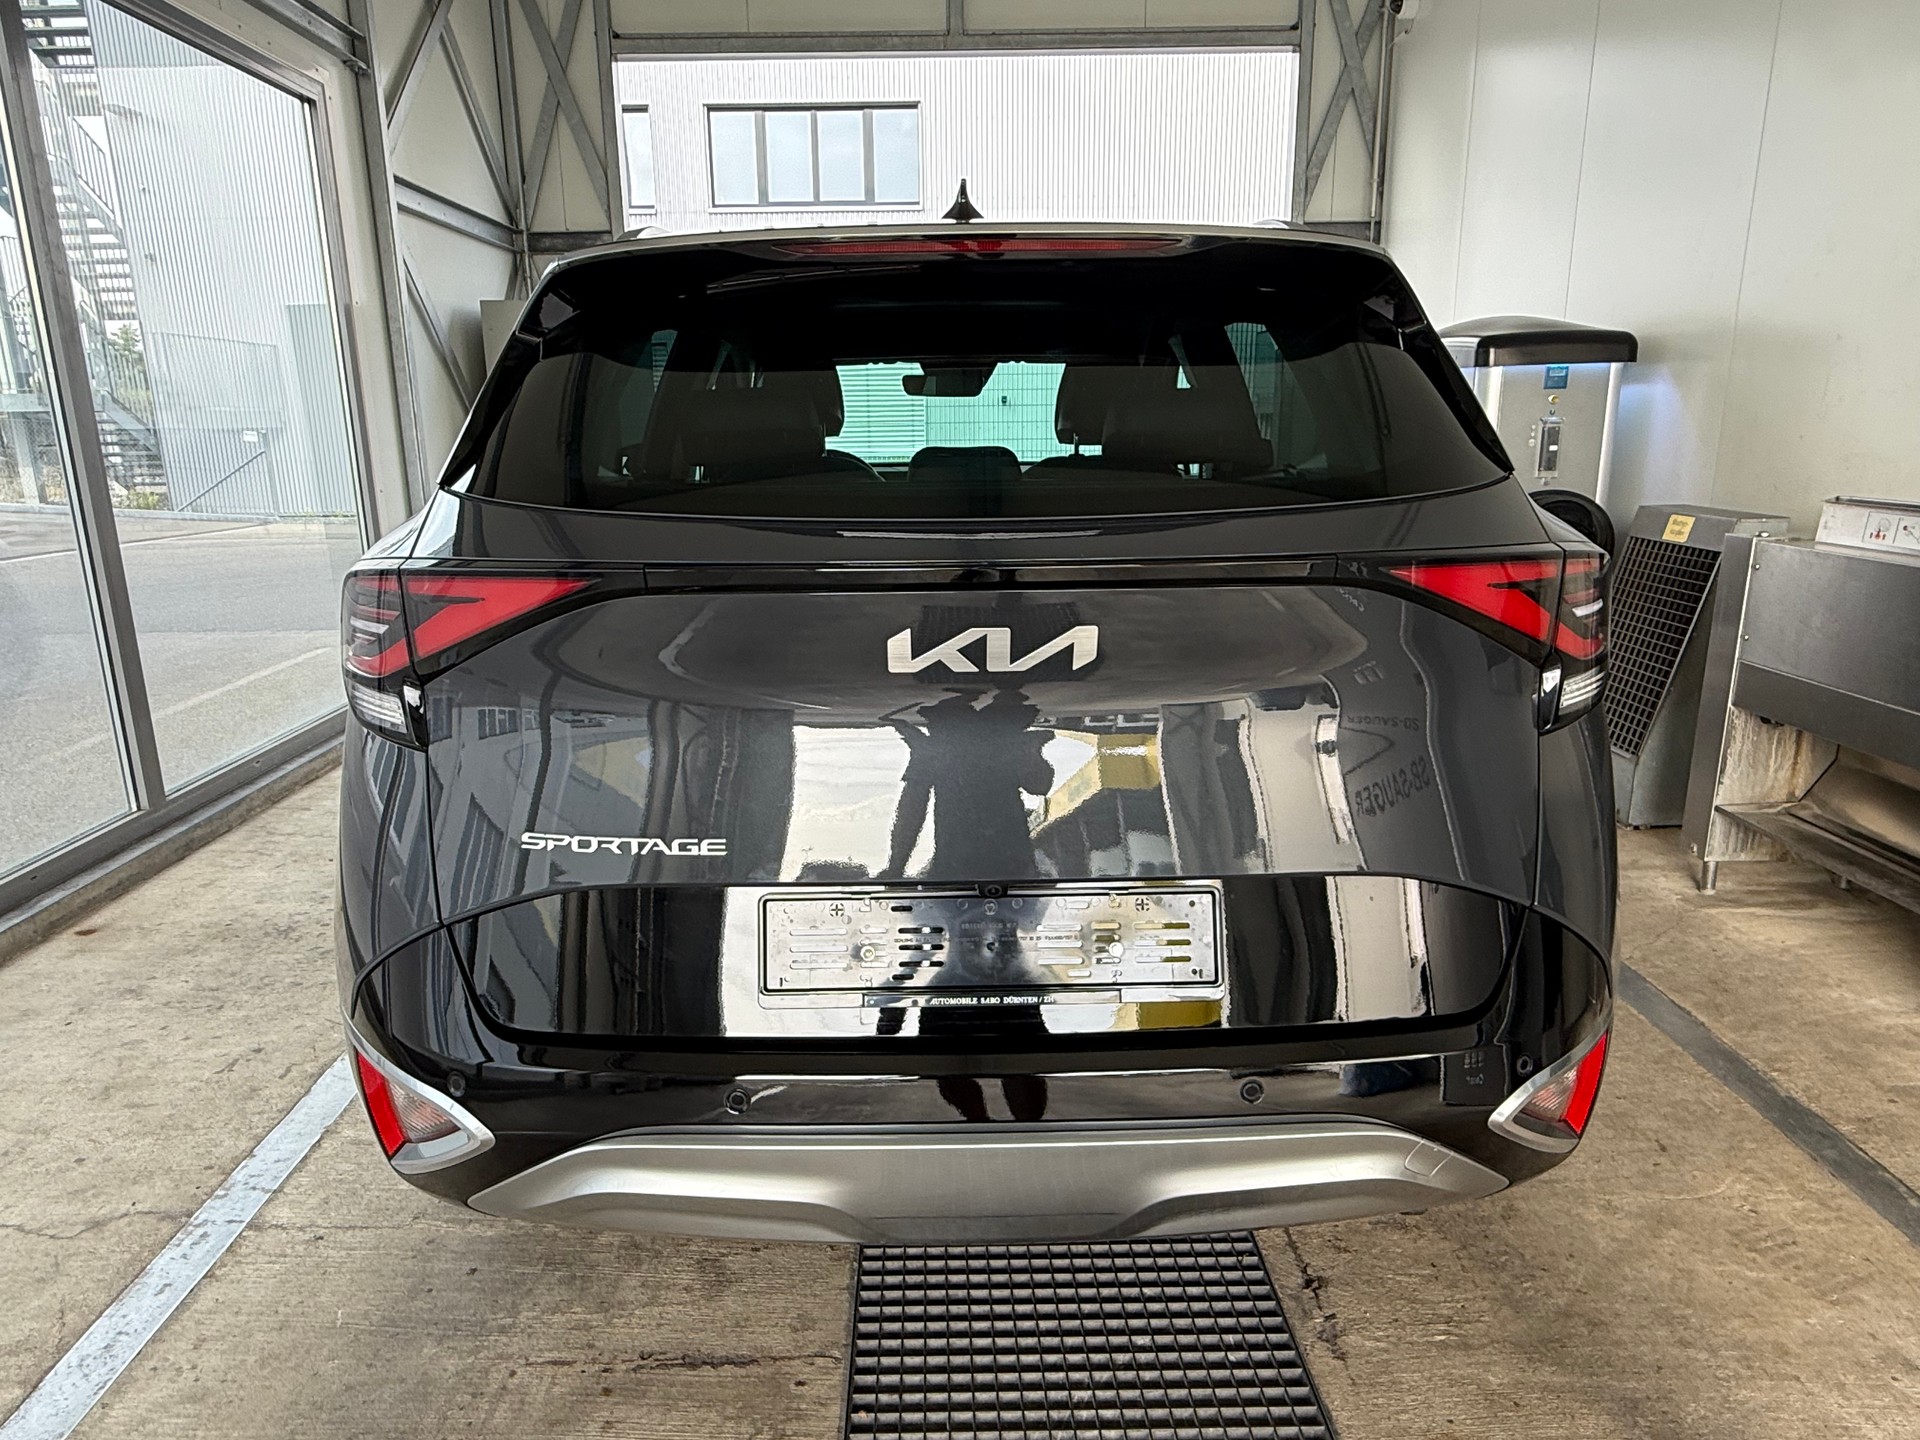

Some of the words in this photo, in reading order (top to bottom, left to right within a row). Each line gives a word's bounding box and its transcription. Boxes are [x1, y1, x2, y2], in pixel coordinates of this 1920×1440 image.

[887, 625, 1099, 673] KIA
[521, 831, 728, 856] SPORTAGE
[930, 996, 978, 1005] AUTOMOBILE
